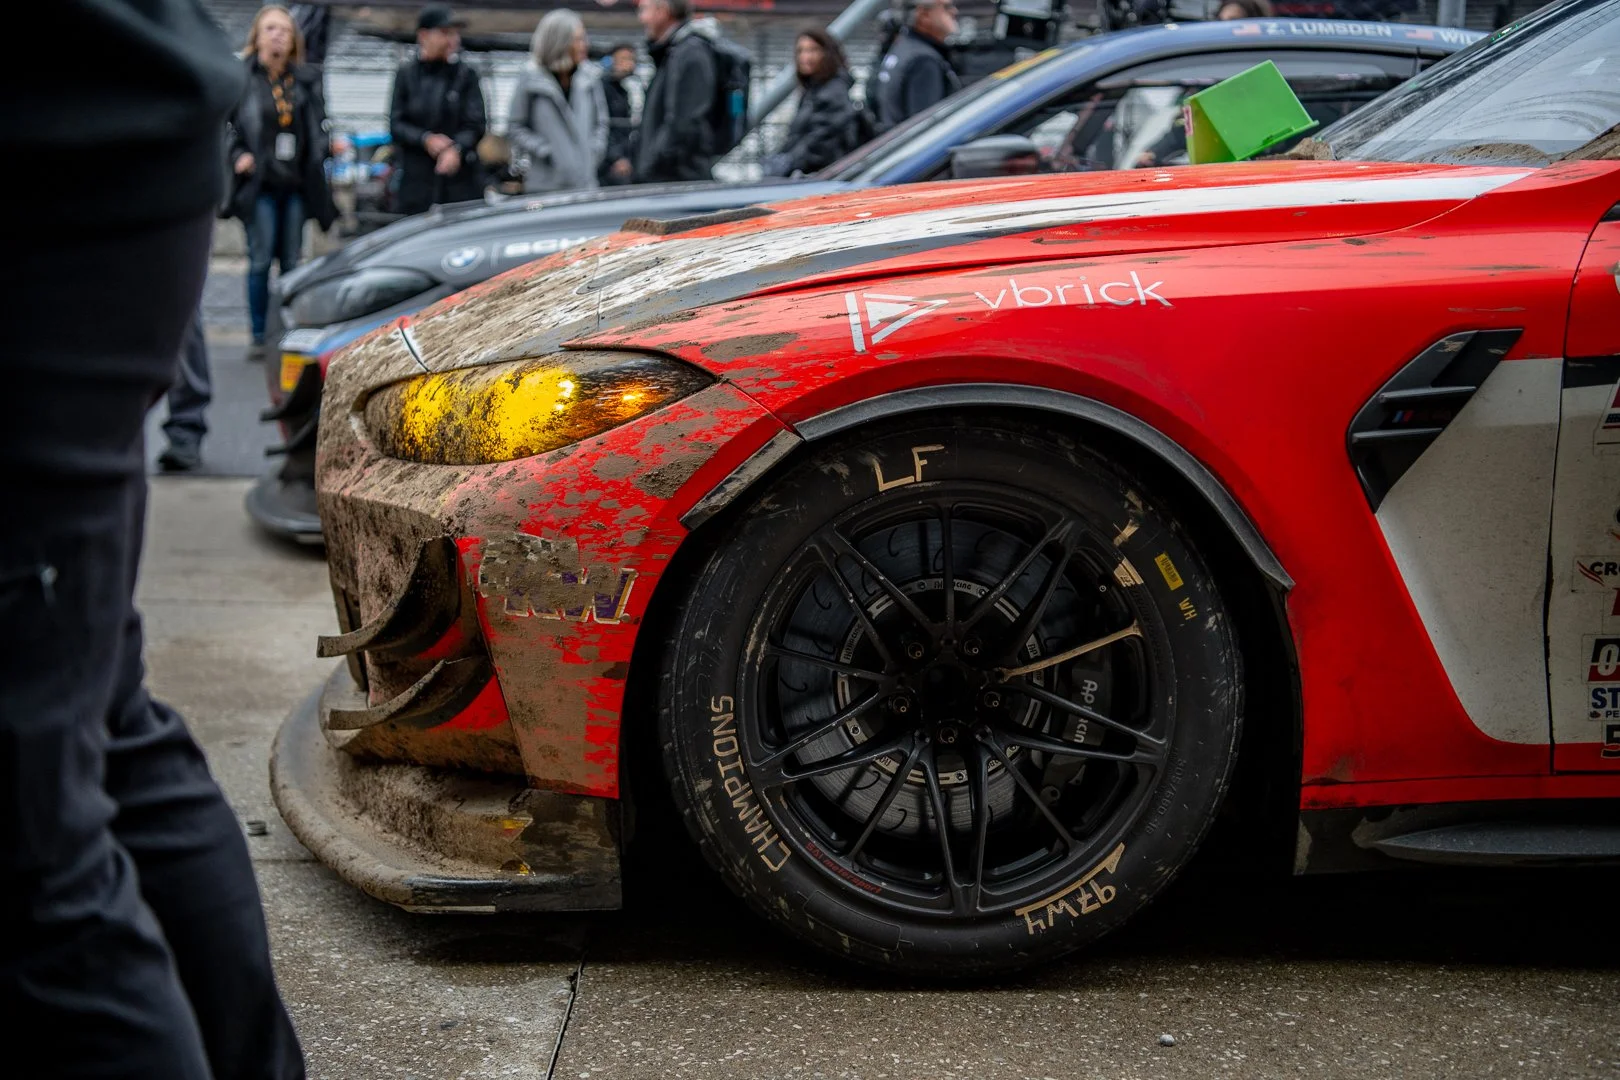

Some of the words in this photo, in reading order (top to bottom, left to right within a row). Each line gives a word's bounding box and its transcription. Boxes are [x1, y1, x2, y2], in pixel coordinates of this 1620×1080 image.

[1289, 22, 1393, 38] LUMSDEN
[974, 271, 1174, 309] vbrick
[872, 443, 945, 492] LF
[1589, 561, 1620, 576] CR
[1179, 597, 1198, 620] WH
[1081, 679, 1099, 704] AP
[711, 695, 792, 872] CHAMPIONS
[1024, 879, 1117, 935] 97W4
